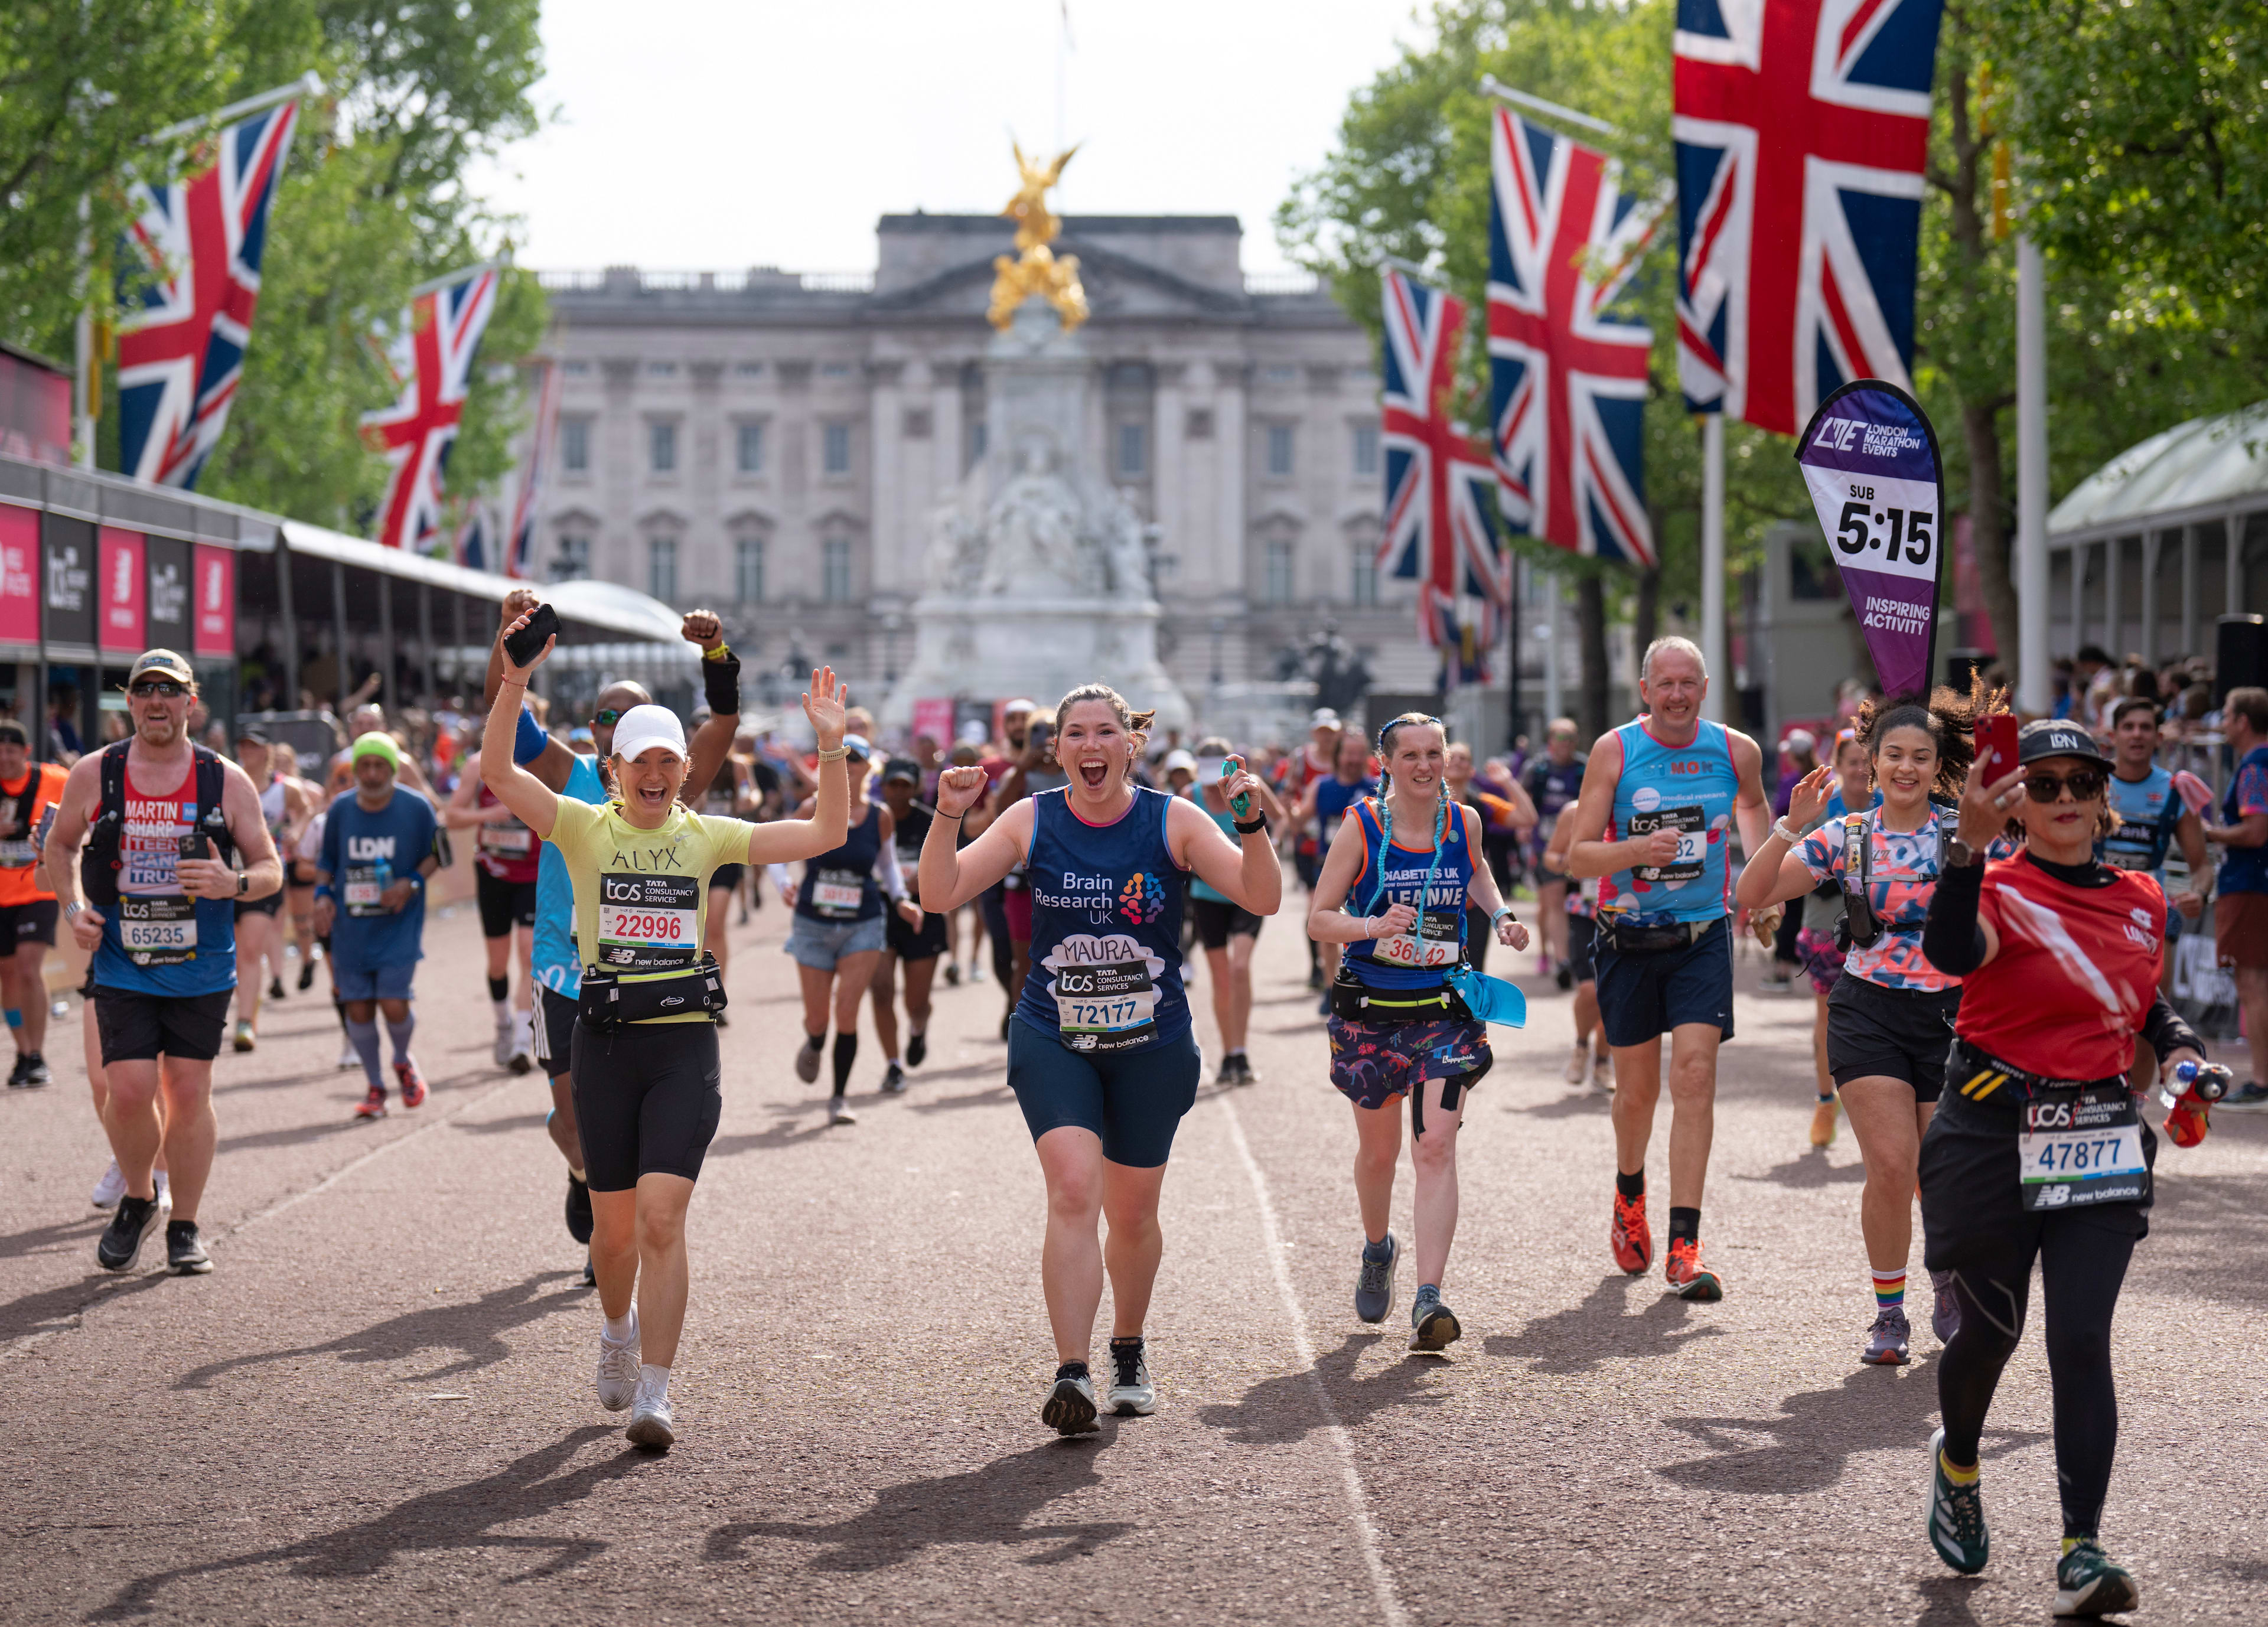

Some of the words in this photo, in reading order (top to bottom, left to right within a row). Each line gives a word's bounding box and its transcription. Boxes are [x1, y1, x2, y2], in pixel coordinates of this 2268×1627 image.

[1866, 423, 1908, 438] LONDON
[1863, 433, 1920, 449] MARATHON
[1862, 443, 1898, 458] EVENTS
[1850, 484, 1875, 500] SUB
[1837, 501, 1933, 565] 5:15
[1866, 596, 1930, 621] INSPIRING
[1863, 612, 1925, 635] ACTIVITY
[2050, 733, 2078, 749] LDN
[1661, 793, 1693, 801] medical
[1695, 791, 1728, 800] research
[125, 800, 177, 820] MARTIN
[126, 818, 175, 838] SHARP
[1631, 816, 1660, 832] tcs
[131, 837, 180, 850] TEEN
[348, 835, 396, 862] LDN
[611, 846, 682, 871] ALYX
[131, 869, 179, 883] TRUS
[1063, 872, 1113, 890] Brain
[1445, 868, 1459, 879] UK
[606, 878, 641, 901] tcs
[645, 887, 694, 896] CONSULTANCY
[1388, 887, 1464, 907] LEANNE
[644, 895, 677, 904] SERVICES
[1035, 887, 1113, 909] Research
[123, 903, 149, 919] tcs
[1090, 910, 1114, 925] UK
[615, 914, 681, 940] 22996
[131, 927, 184, 944] 65235
[1063, 940, 1135, 963] MAURA
[653, 957, 685, 966] balance
[1061, 971, 1093, 992] tcs
[1096, 973, 1143, 984] CONSULTANCY
[1097, 983, 1129, 992] SERVICES
[1072, 1000, 1136, 1025] 72177
[1116, 1035, 1149, 1048] balance
[2039, 1138, 2121, 1170] 47877
[2071, 1192, 2094, 1203] new
[2096, 1186, 2139, 1201] balance
